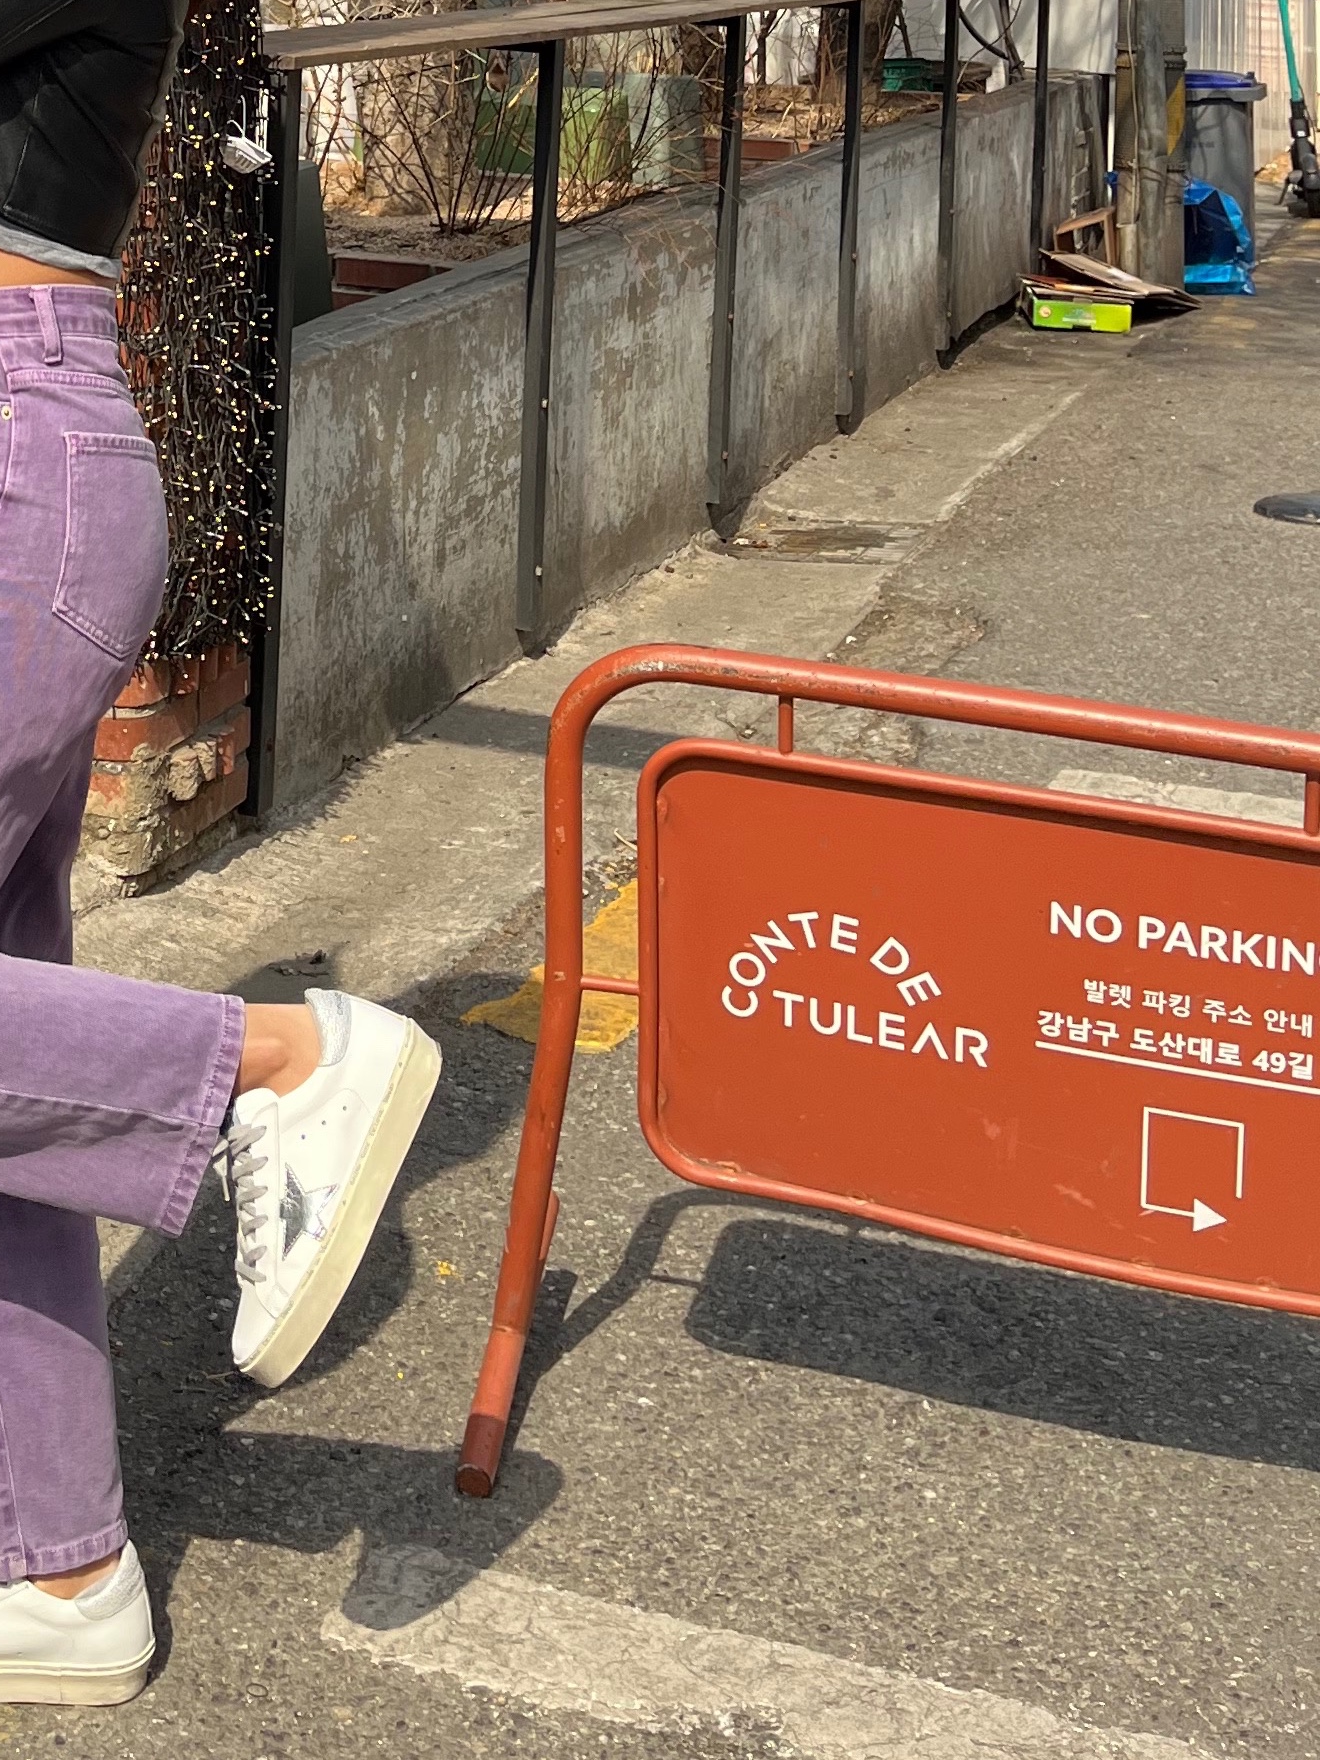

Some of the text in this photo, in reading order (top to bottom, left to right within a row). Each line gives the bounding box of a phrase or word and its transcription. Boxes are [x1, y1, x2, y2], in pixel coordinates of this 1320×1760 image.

[721, 911, 942, 1018] CONTE DE
[1049, 900, 1320, 976] NO PARKIN
[772, 989, 989, 1068] TULEAR
[1037, 1010, 1314, 1081] 강남구 도산대로 49길
[1083, 978, 1314, 1039] 발렛 파킹 주소 안내
